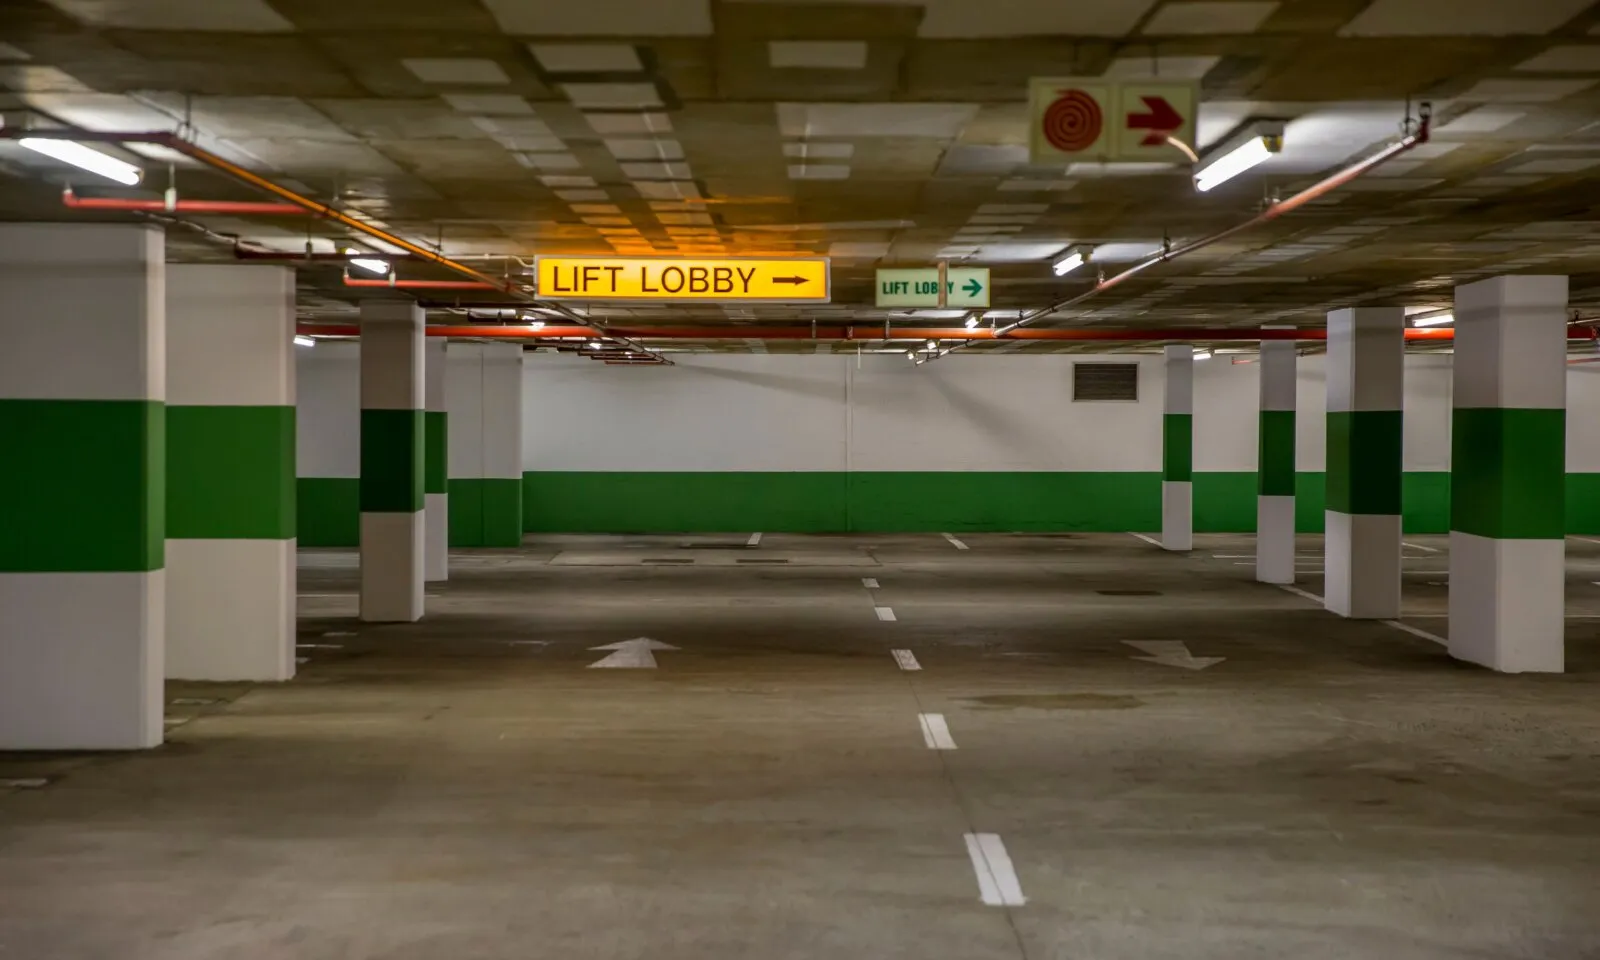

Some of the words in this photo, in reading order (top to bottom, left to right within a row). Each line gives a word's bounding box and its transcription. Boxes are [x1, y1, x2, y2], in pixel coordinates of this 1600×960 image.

[553, 266, 624, 292] LIFT
[641, 266, 756, 293] LOBBY
[882, 281, 909, 295] LIFT
[915, 281, 954, 295] LOBY
